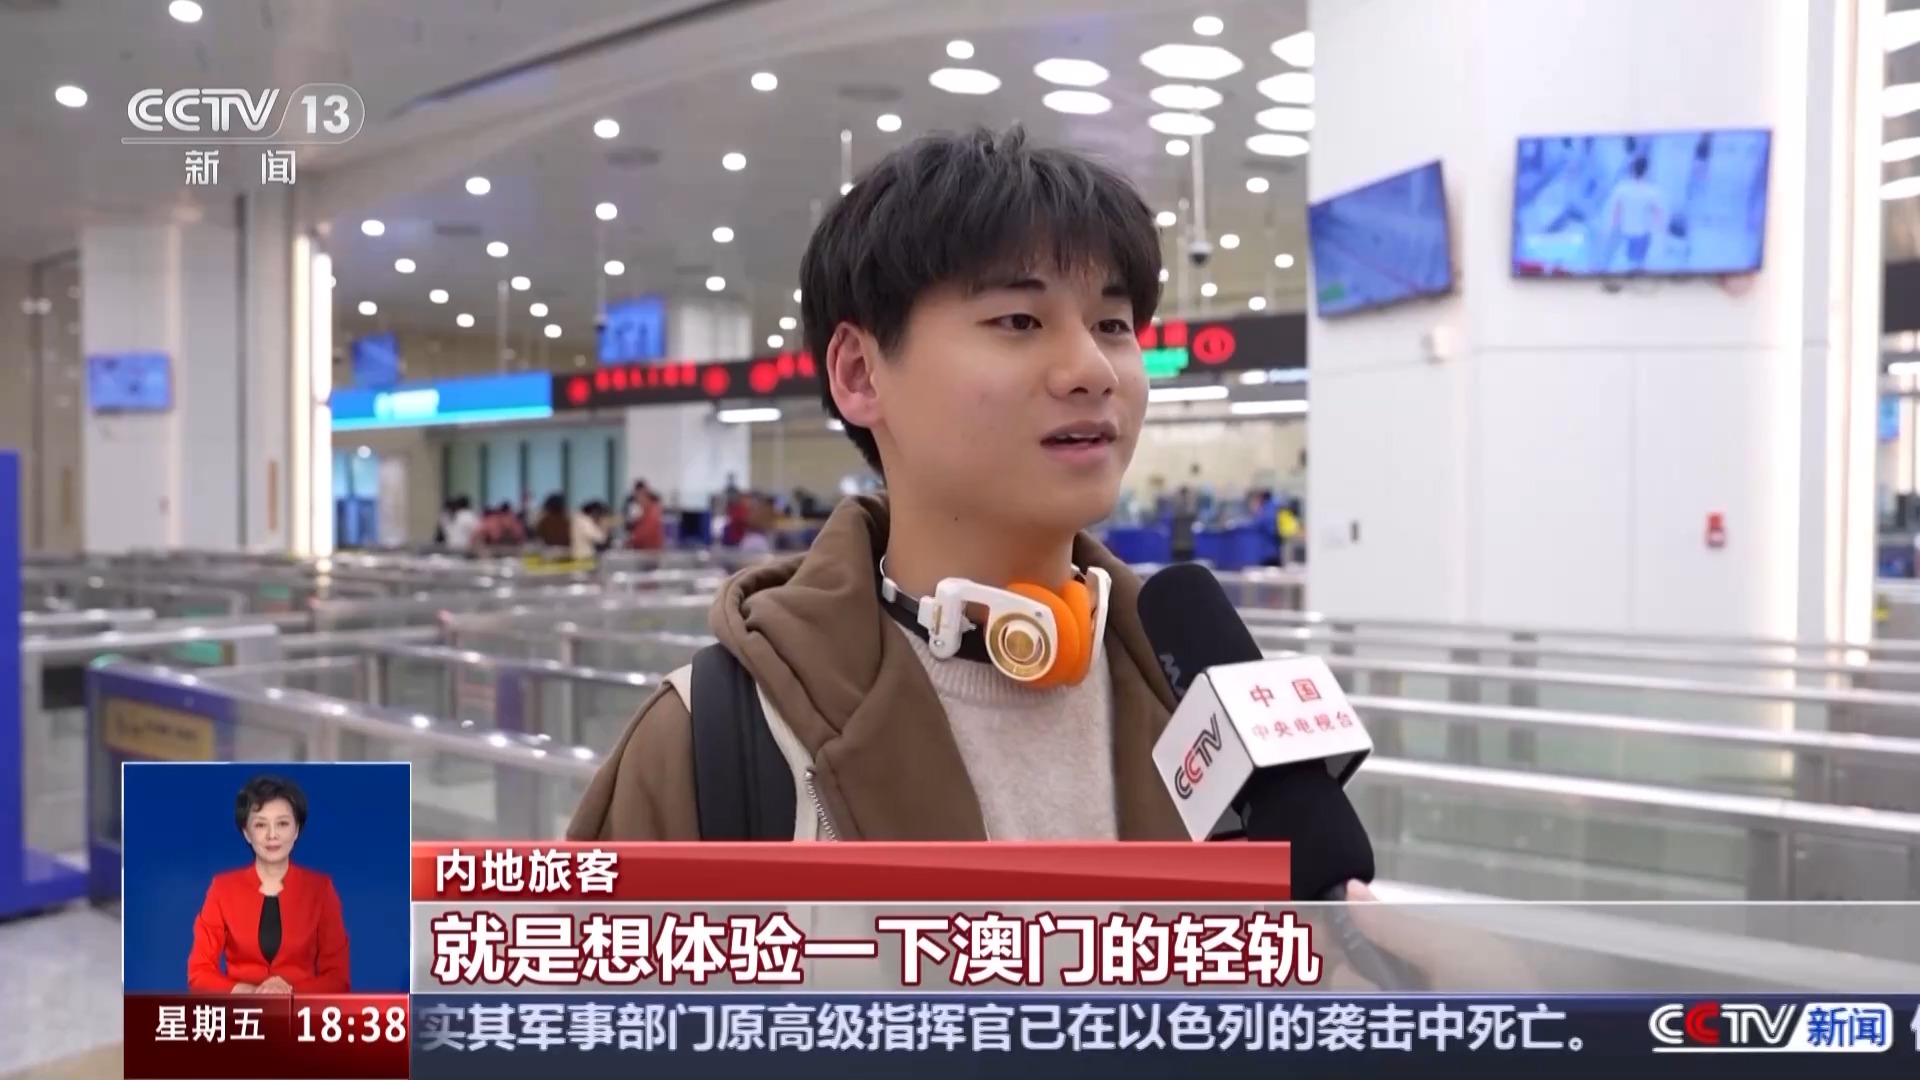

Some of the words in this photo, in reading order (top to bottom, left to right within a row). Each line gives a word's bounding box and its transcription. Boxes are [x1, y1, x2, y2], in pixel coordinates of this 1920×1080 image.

[1252, 711, 1354, 741] 中央电视台
[1174, 712, 1222, 800] CCTV
